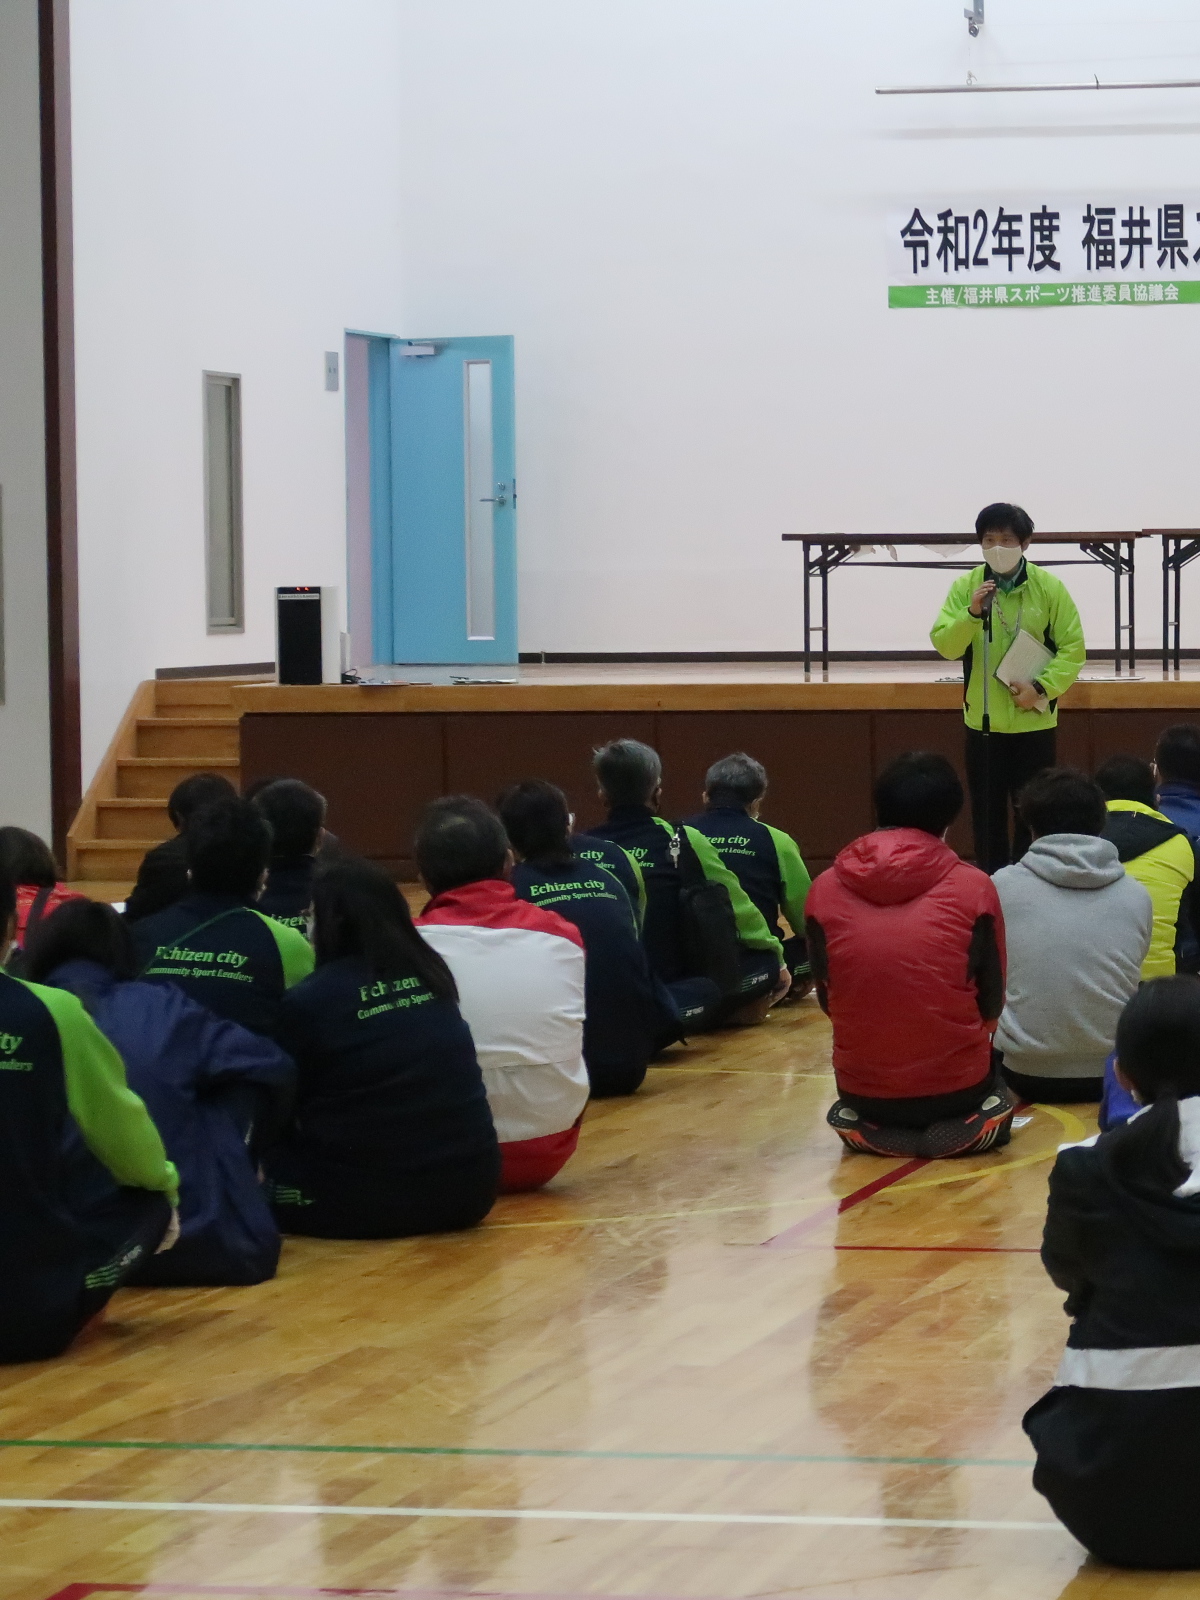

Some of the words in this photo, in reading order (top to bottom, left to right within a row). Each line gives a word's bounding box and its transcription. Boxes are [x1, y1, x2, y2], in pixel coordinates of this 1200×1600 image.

[900, 204, 1061, 274] 令和2年度
[925, 283, 1180, 306] 主催/福井県スポーツ推進委員協議会
[727, 835, 751, 847] city
[579, 850, 605, 861] city
[529, 881, 582, 897] Echizen
[583, 879, 606, 890] city
[572, 892, 593, 900] Sport
[216, 950, 250, 968] city
[190, 967, 216, 979] Sport
[217, 969, 254, 983] Leaders
